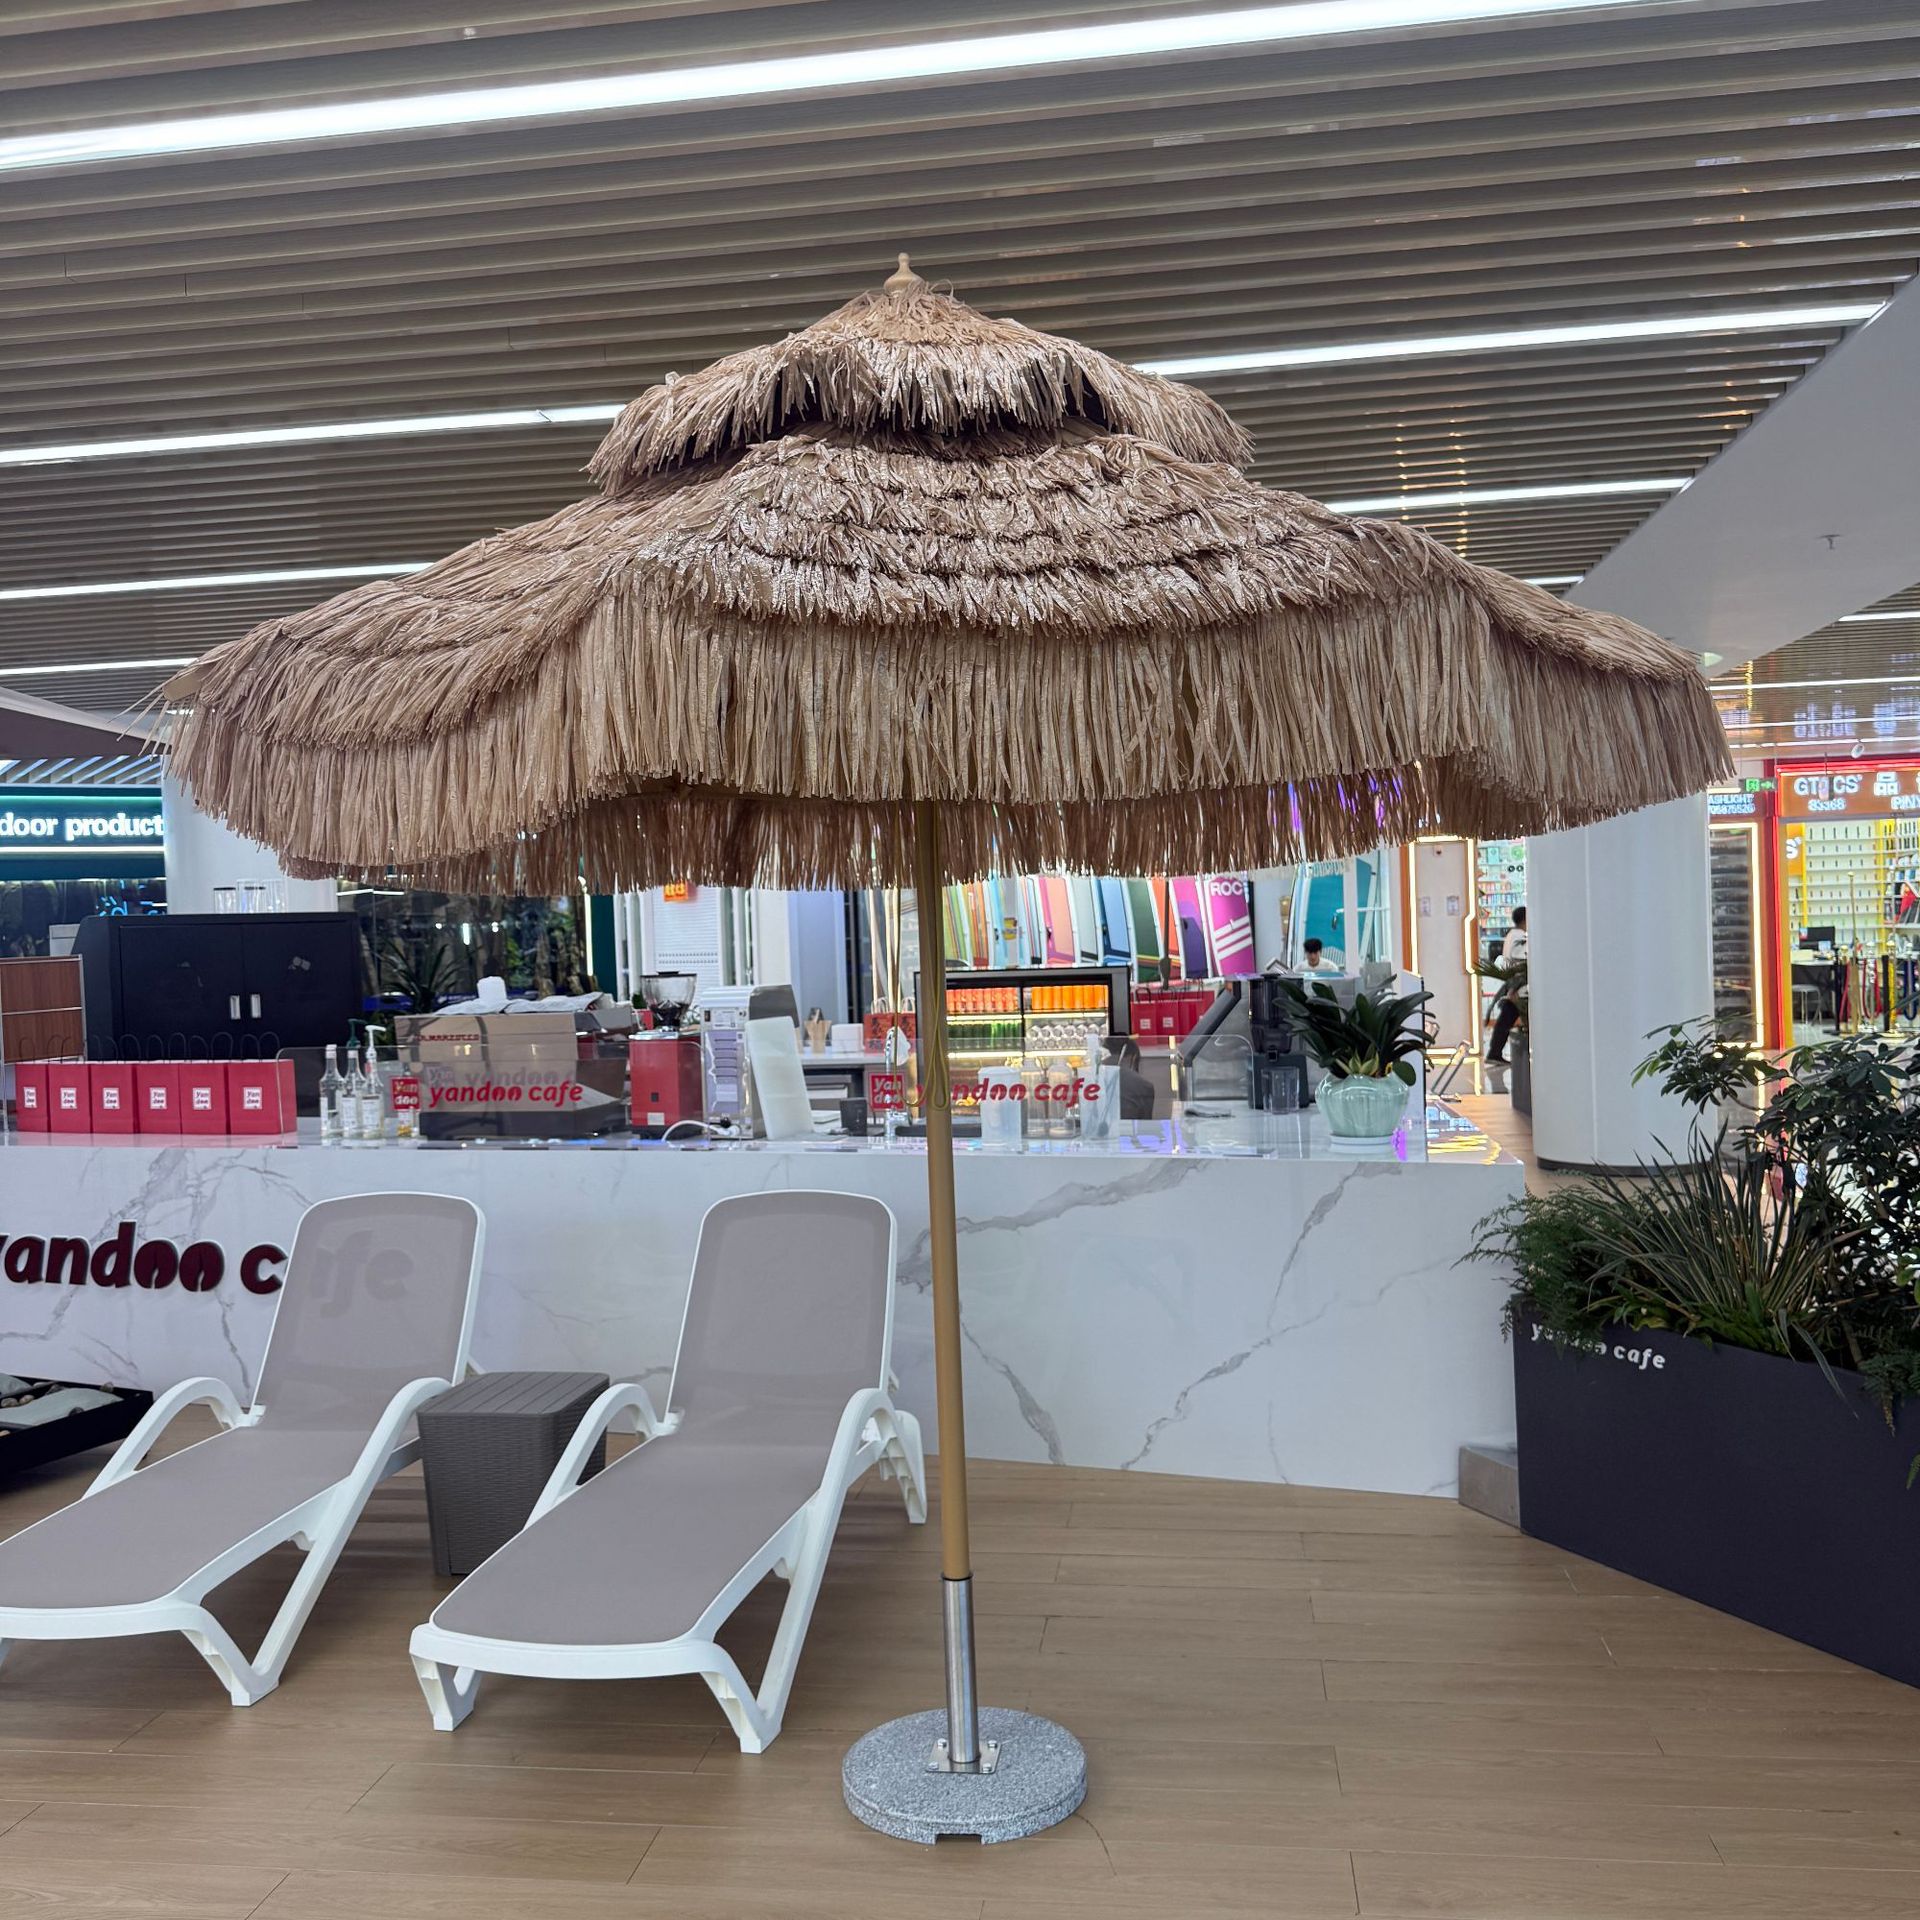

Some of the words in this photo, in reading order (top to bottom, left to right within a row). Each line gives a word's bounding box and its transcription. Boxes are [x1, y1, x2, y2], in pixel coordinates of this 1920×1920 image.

[1210, 881, 1243, 897] ROC
[429, 1081, 522, 1108] yandoo
[528, 1080, 583, 1107] cafe
[1034, 1078, 1100, 1108] cafe
[0, 1221, 224, 1292] andoo
[1613, 1345, 1666, 1370] cafe
